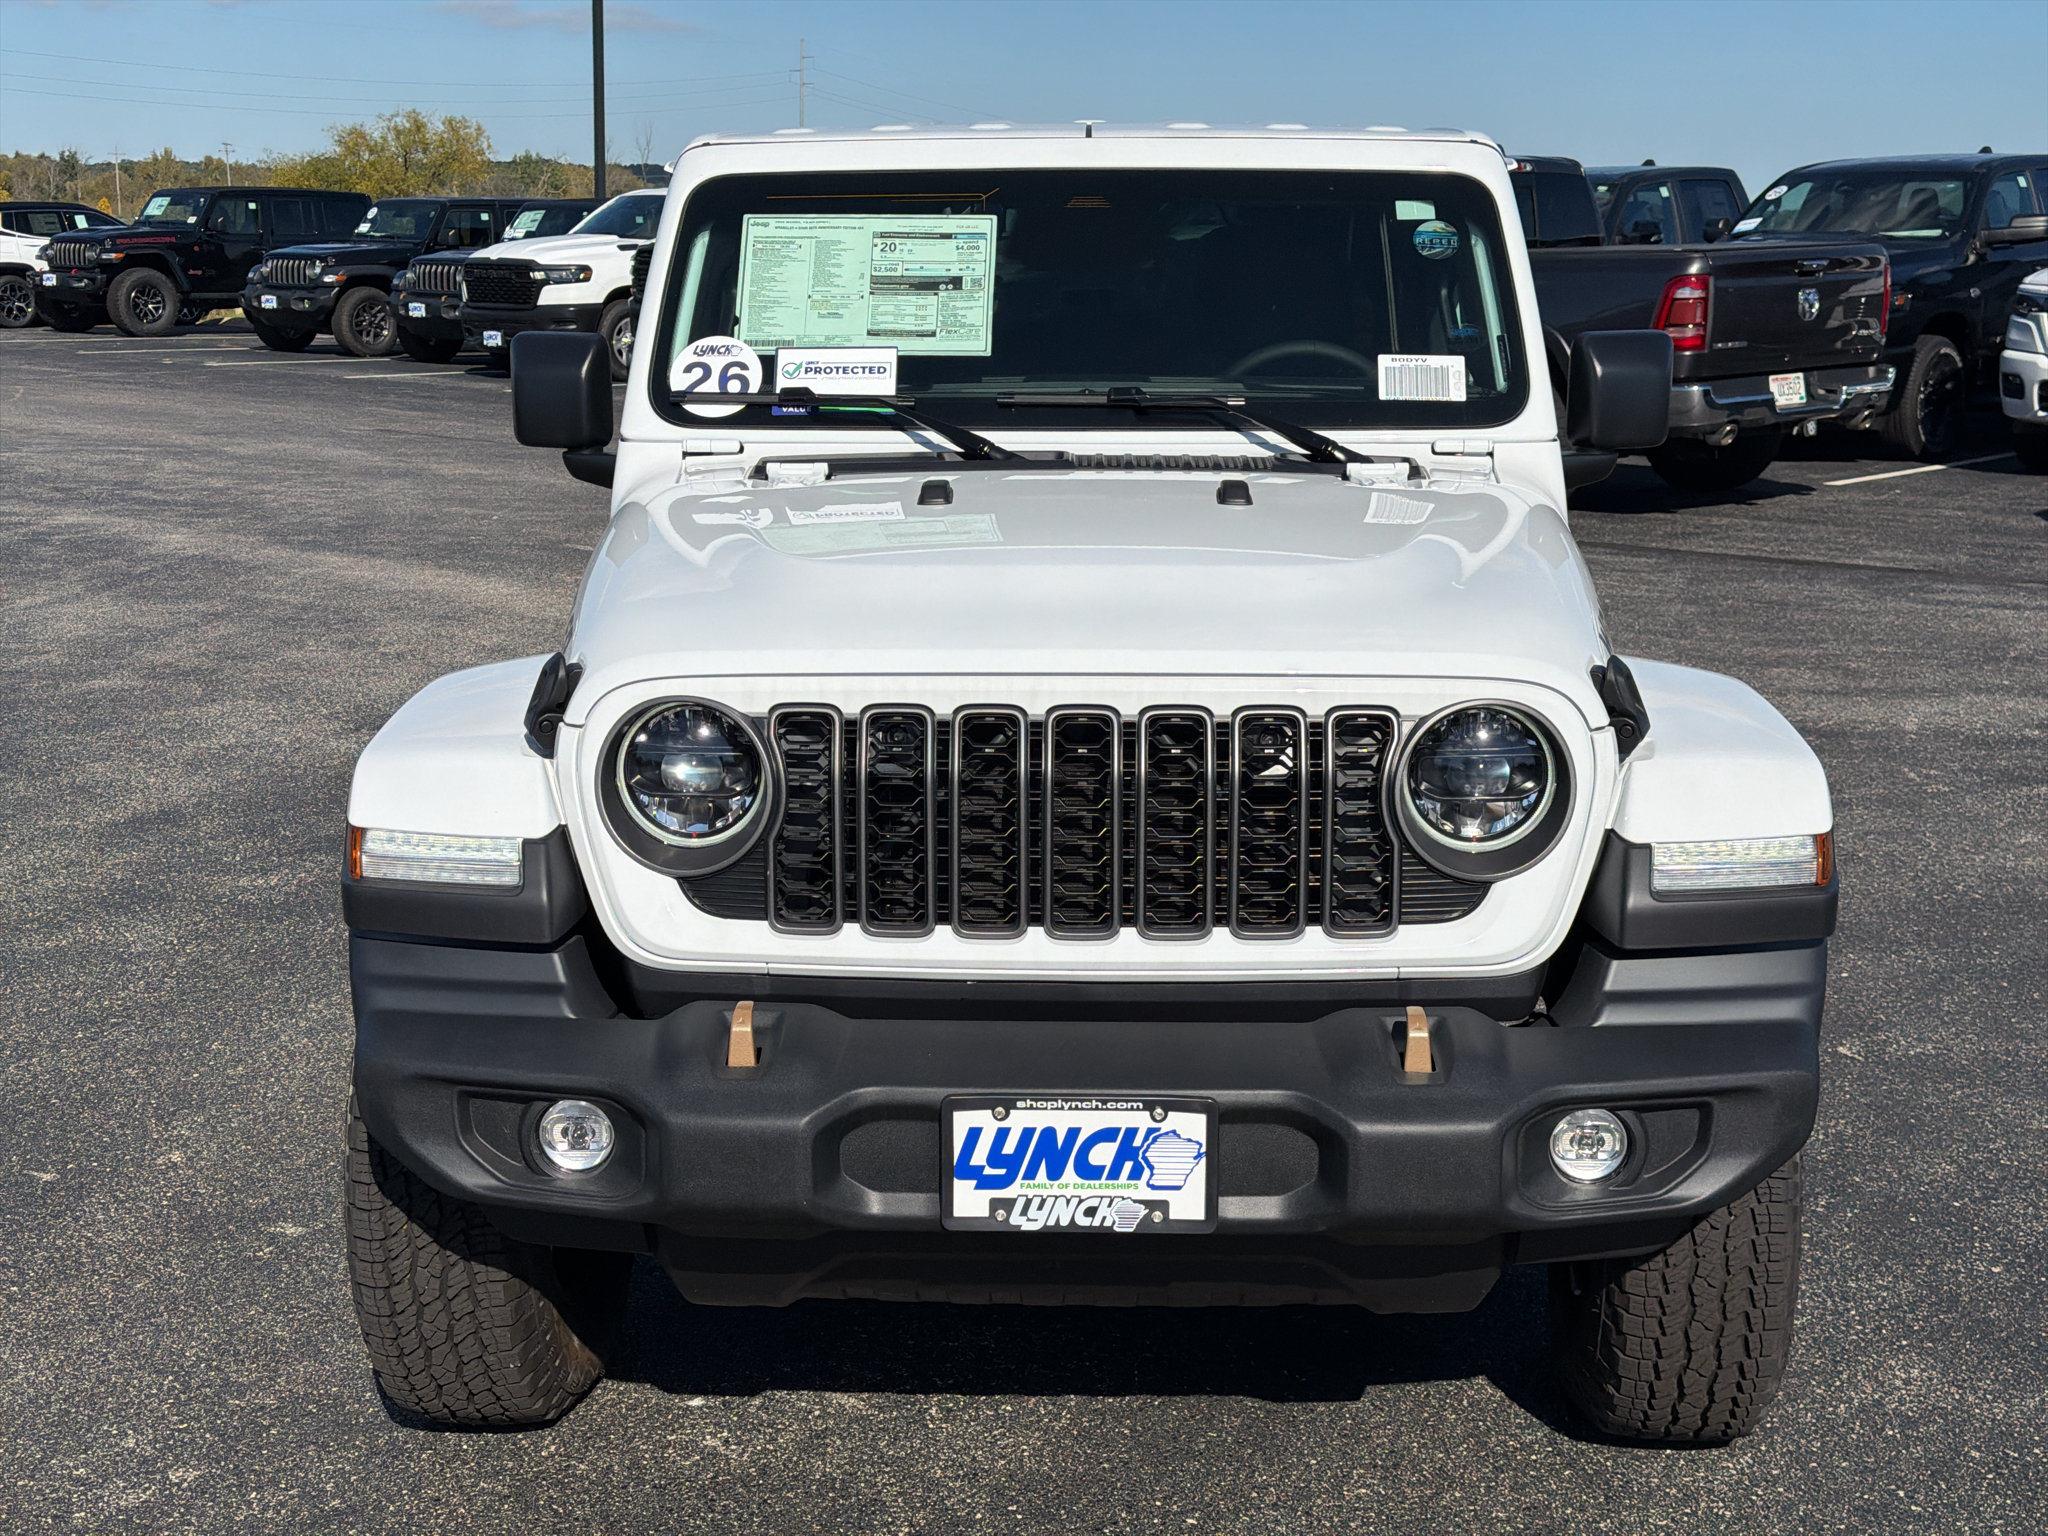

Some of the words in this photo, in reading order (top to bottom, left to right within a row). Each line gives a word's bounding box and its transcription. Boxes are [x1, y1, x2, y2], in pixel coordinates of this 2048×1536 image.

[880, 241, 897, 253] 20
[693, 345, 731, 357] LYNCH
[682, 360, 751, 393] 26
[804, 366, 888, 375] PROTECTED
[1016, 1099, 1143, 1110] shoplynch.com
[953, 1126, 1162, 1190] LYNCH
[1020, 1182, 1055, 1190] FAMILY
[1057, 1182, 1071, 1190] OF
[1073, 1182, 1139, 1190] DEALERSHIPS
[1009, 1194, 1124, 1230] LYNCH
